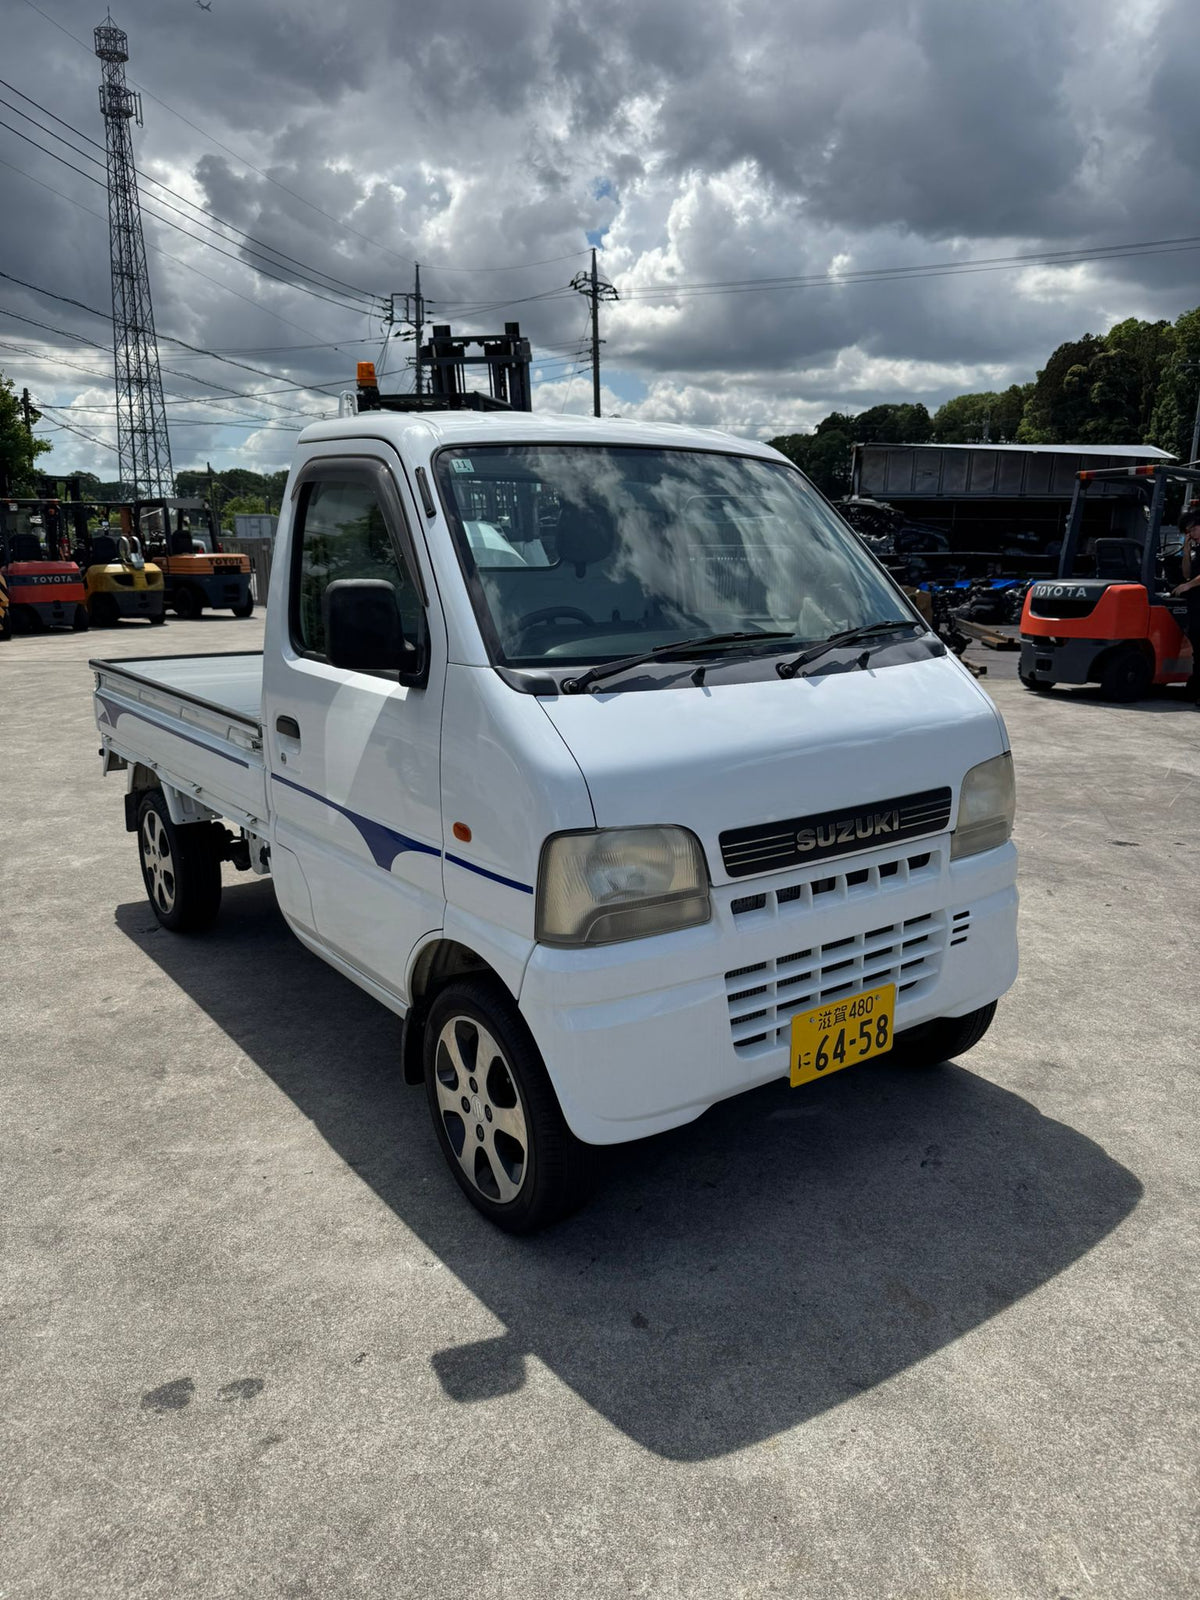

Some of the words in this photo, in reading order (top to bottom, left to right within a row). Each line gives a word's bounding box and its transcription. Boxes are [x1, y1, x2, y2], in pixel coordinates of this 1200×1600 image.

[207, 557, 243, 566] TOYOTA
[32, 575, 73, 583] TOYOTA
[1035, 585, 1087, 597] TOYOTA
[796, 809, 899, 851] SUZUKI
[818, 1005, 848, 1032] 滋賀
[849, 995, 874, 1019] 480
[815, 1014, 889, 1071] 64-58
